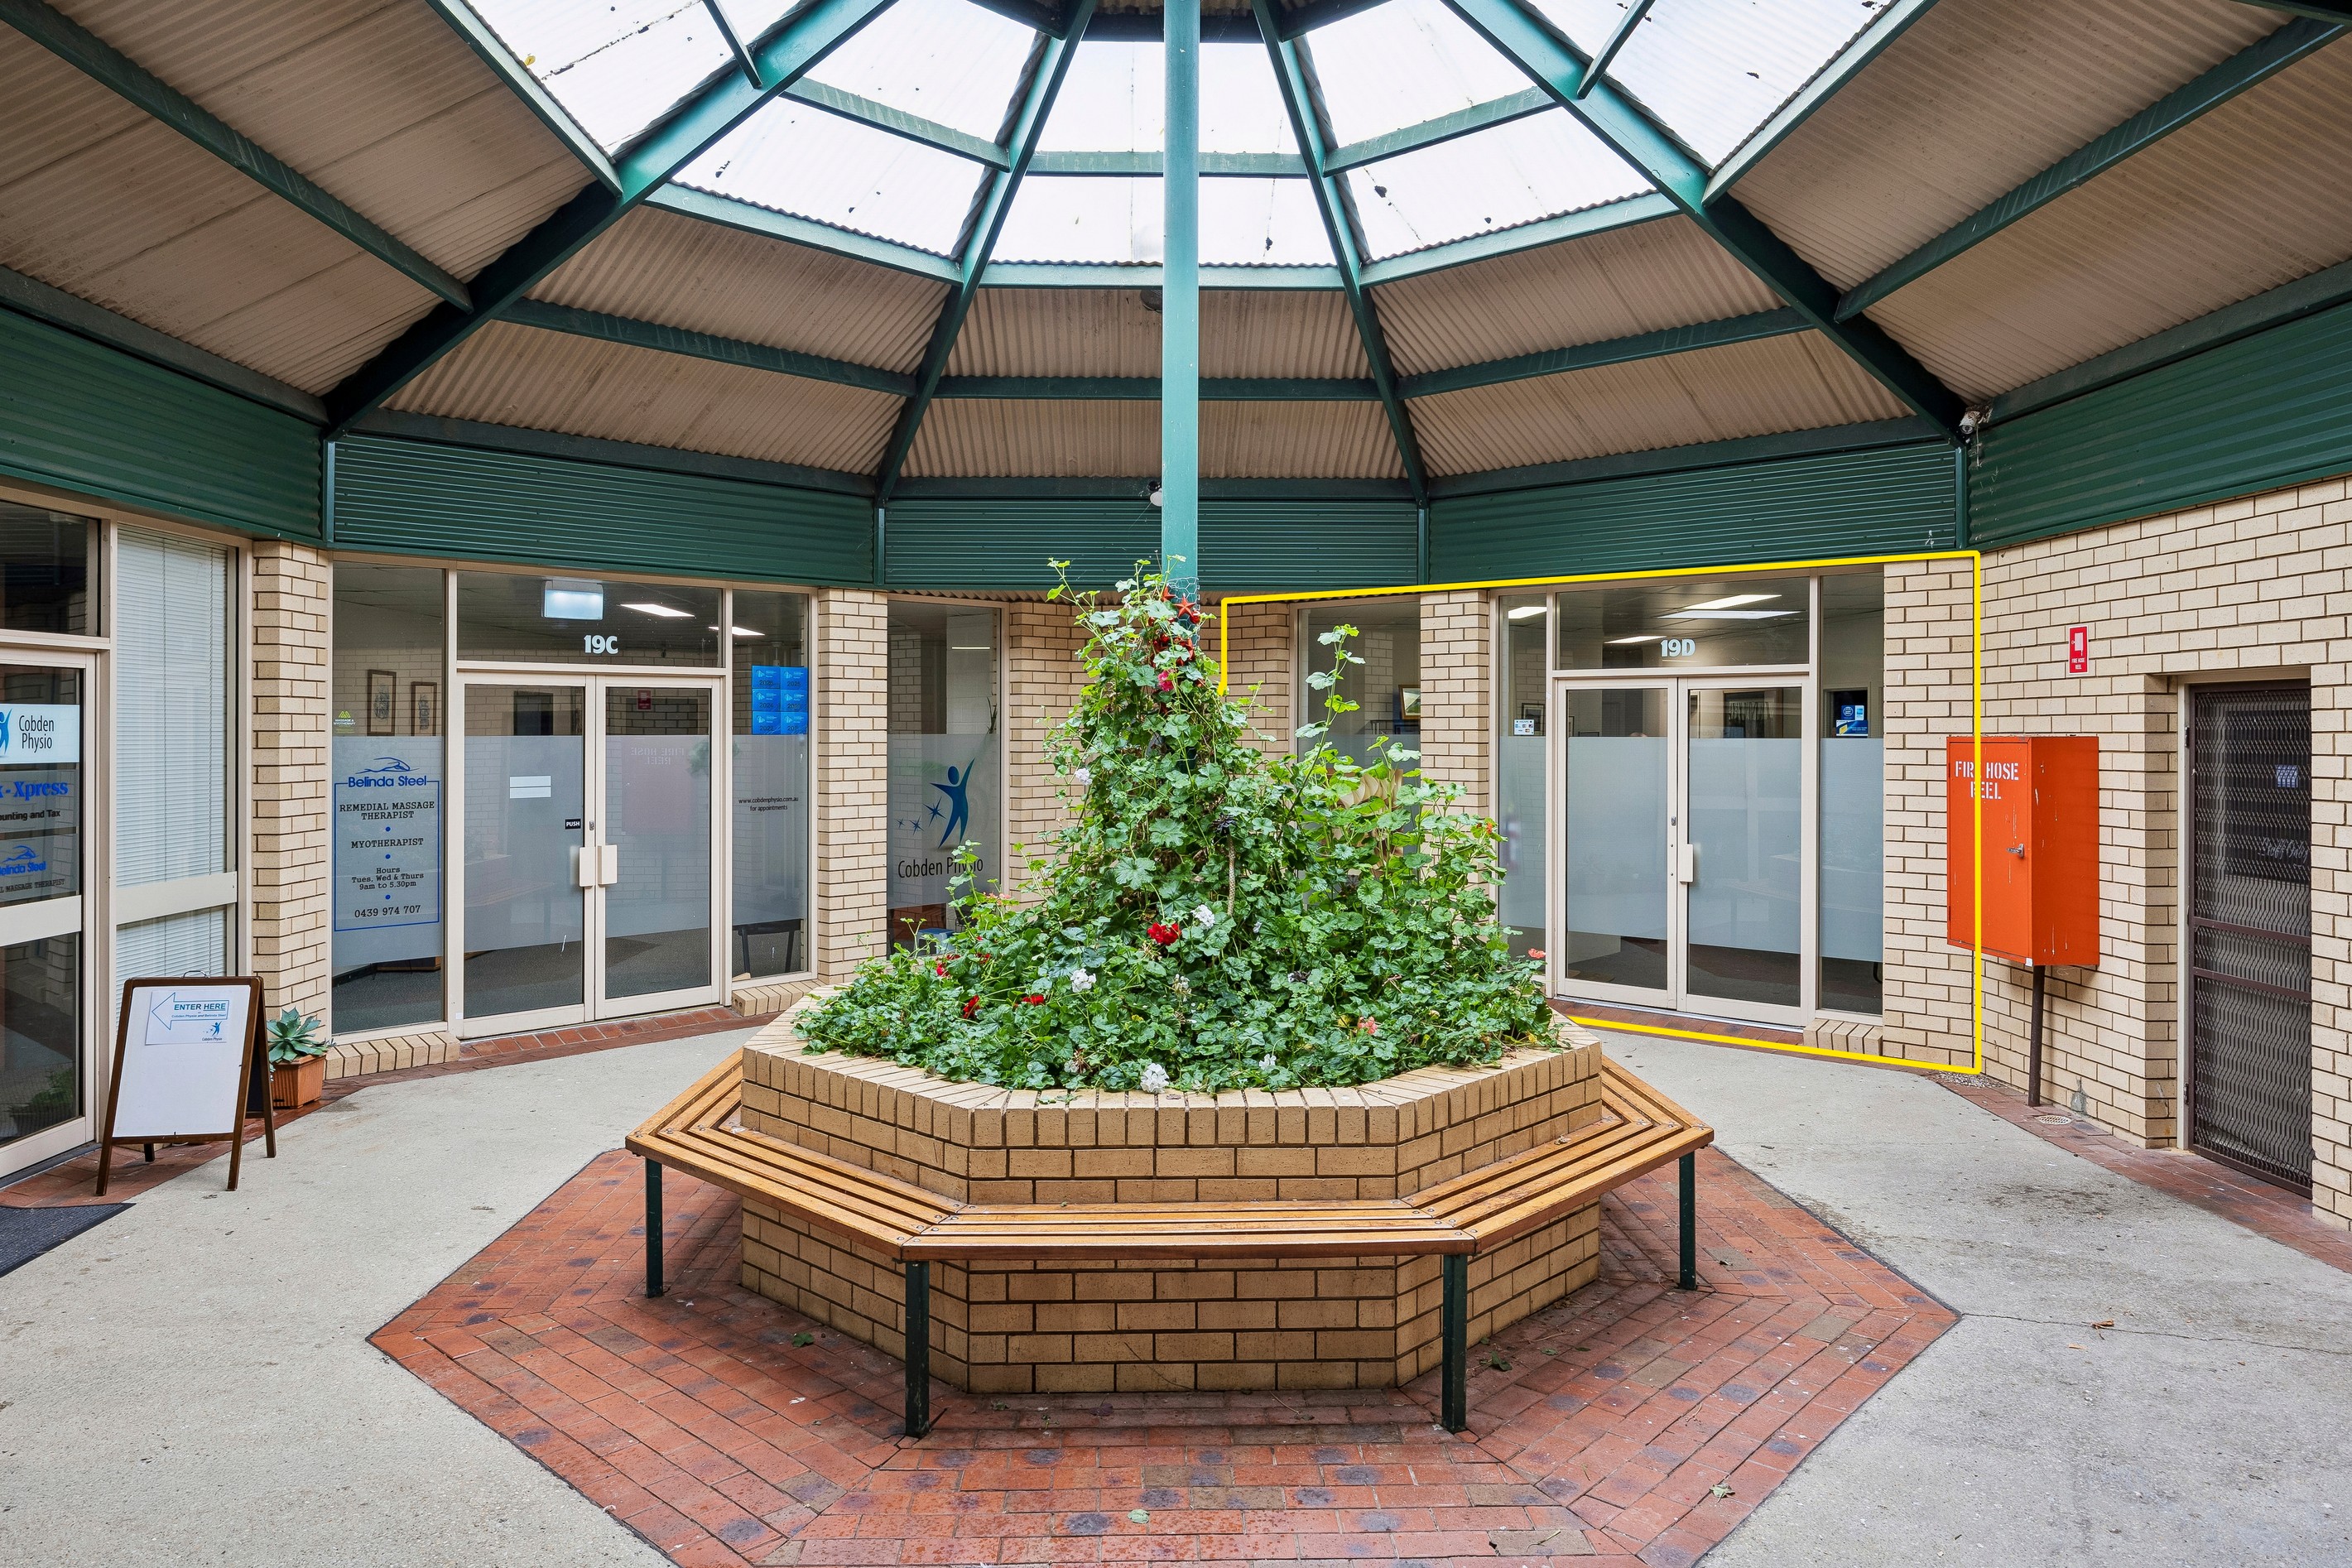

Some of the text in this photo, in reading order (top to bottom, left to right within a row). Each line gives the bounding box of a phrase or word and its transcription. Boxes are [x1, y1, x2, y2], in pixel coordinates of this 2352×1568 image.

[584, 634, 618, 654] 19C
[1660, 638, 1695, 657] 19D
[19, 715, 55, 732] Cobden
[22, 733, 53, 753] Physio
[1955, 761, 2019, 780] FIR HOSE
[348, 775, 427, 787] Belinda Steel
[339, 801, 435, 812] REMEDIAL MASSAGE
[29, 810, 45, 819] and
[46, 809, 61, 817] Tax
[361, 810, 415, 820] THERAPIST
[351, 838, 424, 849] MYOTHERAPIST
[897, 859, 943, 878] Cobden
[35, 878, 65, 889] THERAPIST
[389, 880, 417, 888] 5.30pm
[354, 905, 421, 918] 0439 974 707
